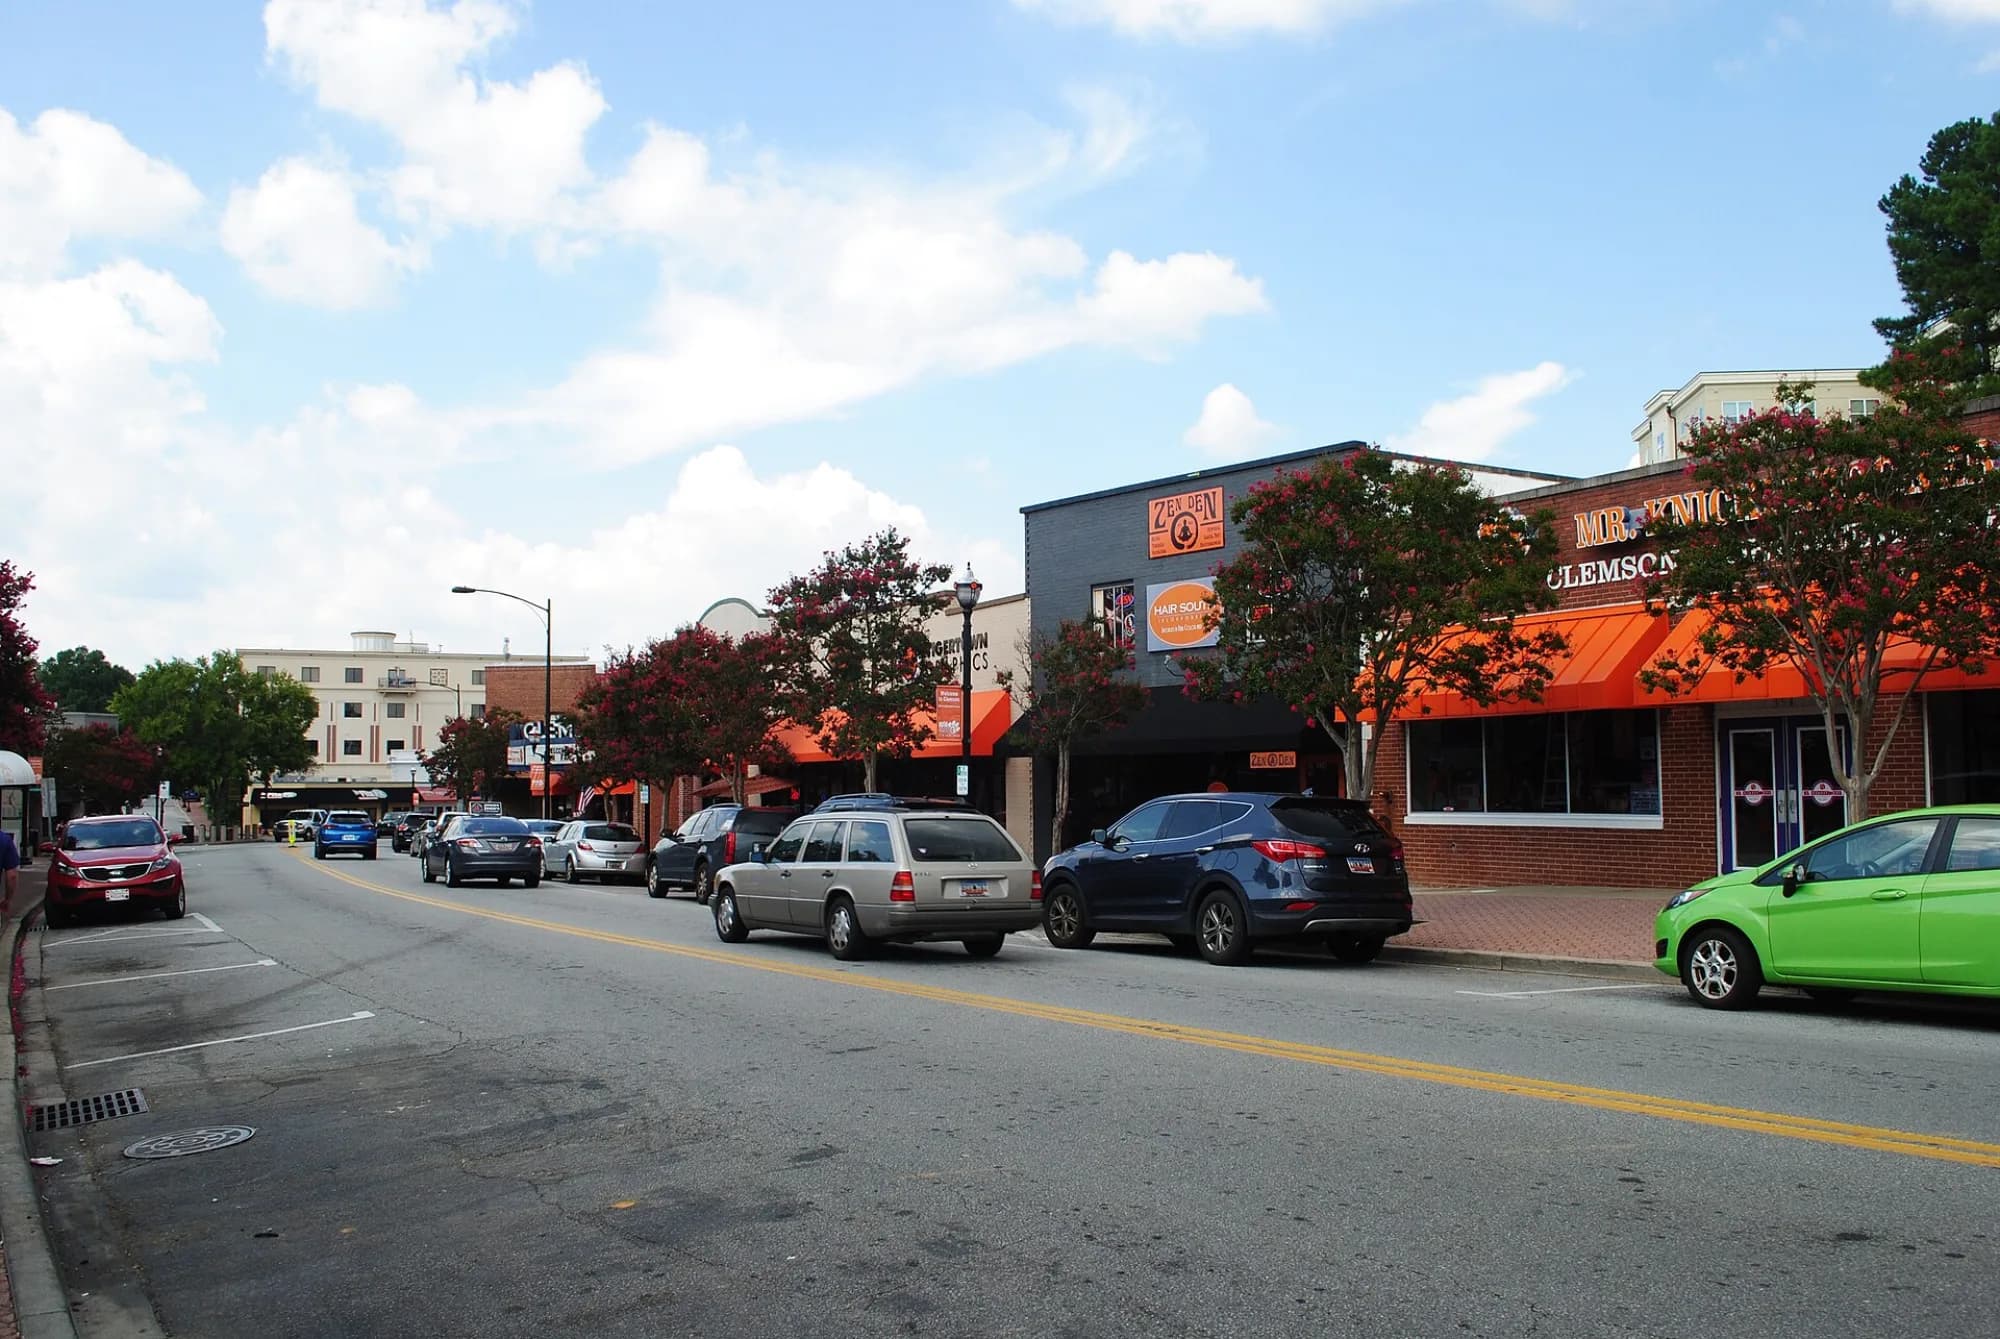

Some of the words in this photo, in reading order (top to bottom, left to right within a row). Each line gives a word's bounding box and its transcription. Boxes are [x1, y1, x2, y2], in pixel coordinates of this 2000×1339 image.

[1154, 498, 1181, 529] ZEN
[1188, 491, 1216, 520] DEN
[1574, 506, 1637, 549] MR.
[1154, 603, 1177, 616] HAIR
